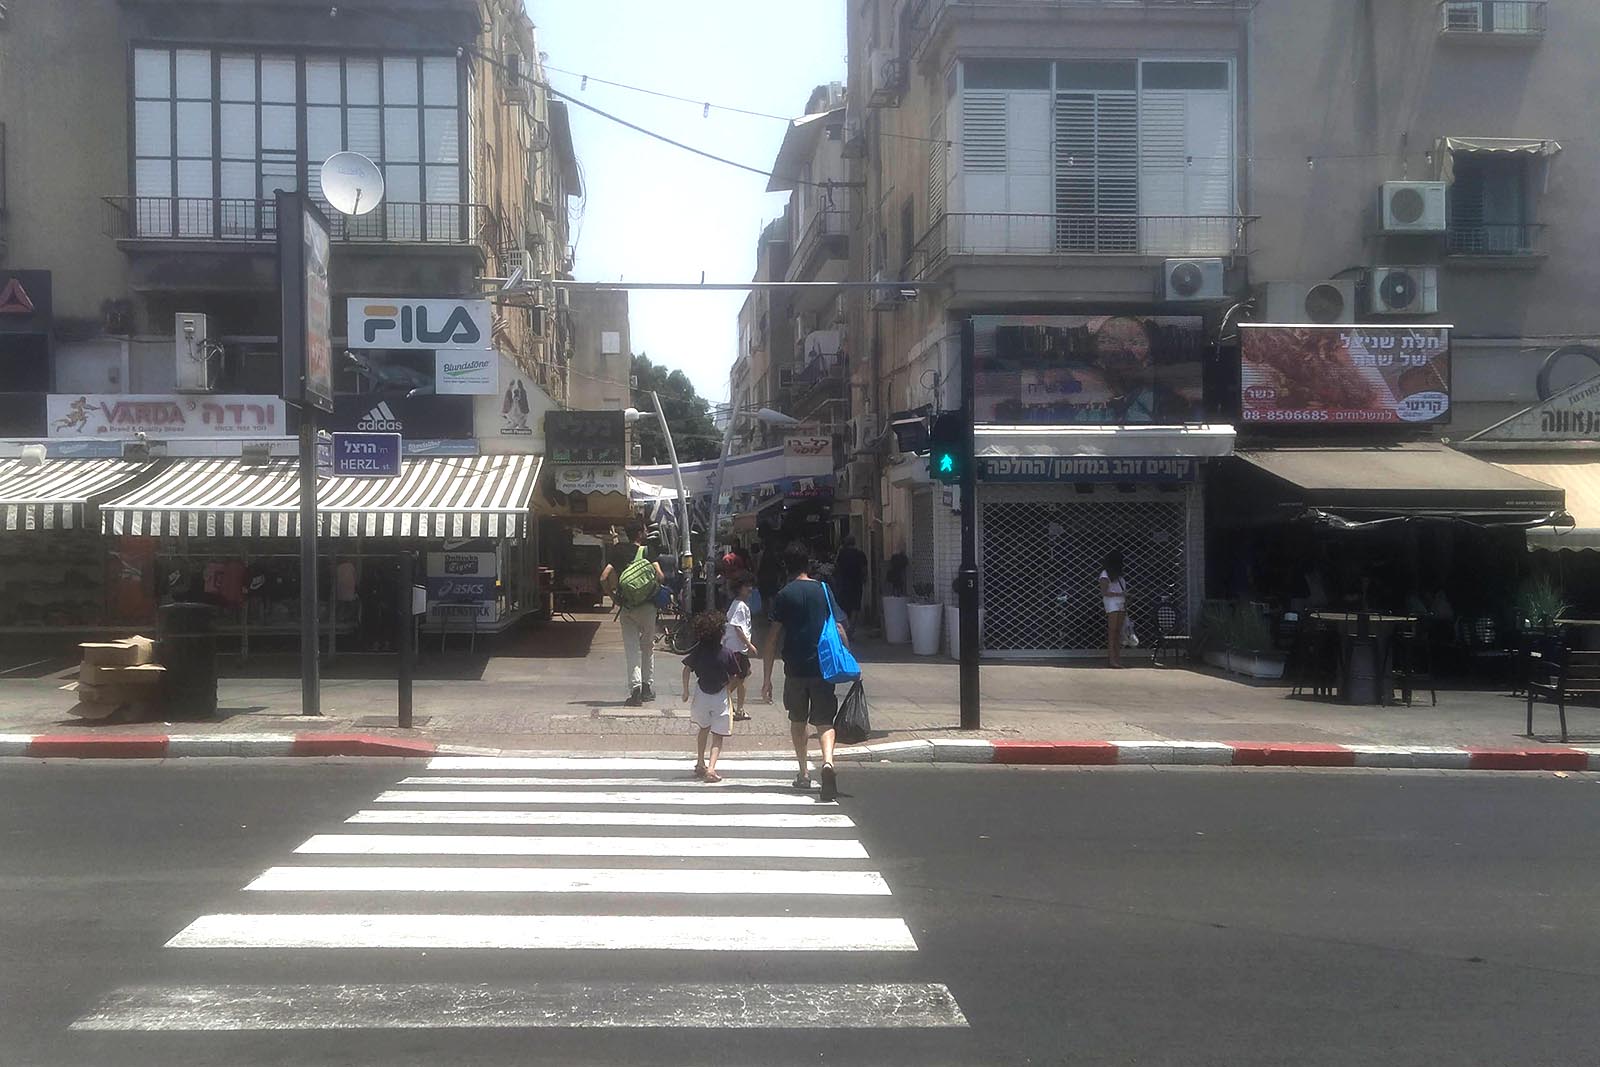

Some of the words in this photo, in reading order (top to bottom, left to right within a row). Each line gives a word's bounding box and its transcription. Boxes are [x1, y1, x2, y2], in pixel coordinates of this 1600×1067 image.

[364, 305, 481, 343] FILA
[1401, 333, 1439, 349] חלת
[444, 360, 489, 372] Blundstone
[1400, 352, 1426, 367] של
[1247, 388, 1275, 399] כשר
[100, 401, 185, 424] VARDA
[202, 402, 275, 425] ורדה
[1242, 410, 1329, 421] 08-8506685
[357, 418, 403, 431] adidas
[344, 440, 377, 454] הרצל
[340, 459, 380, 470] HERZL
[1113, 459, 1141, 475] זהב
[1146, 459, 1190, 479] קונים
[967, 579, 974, 588] 3
